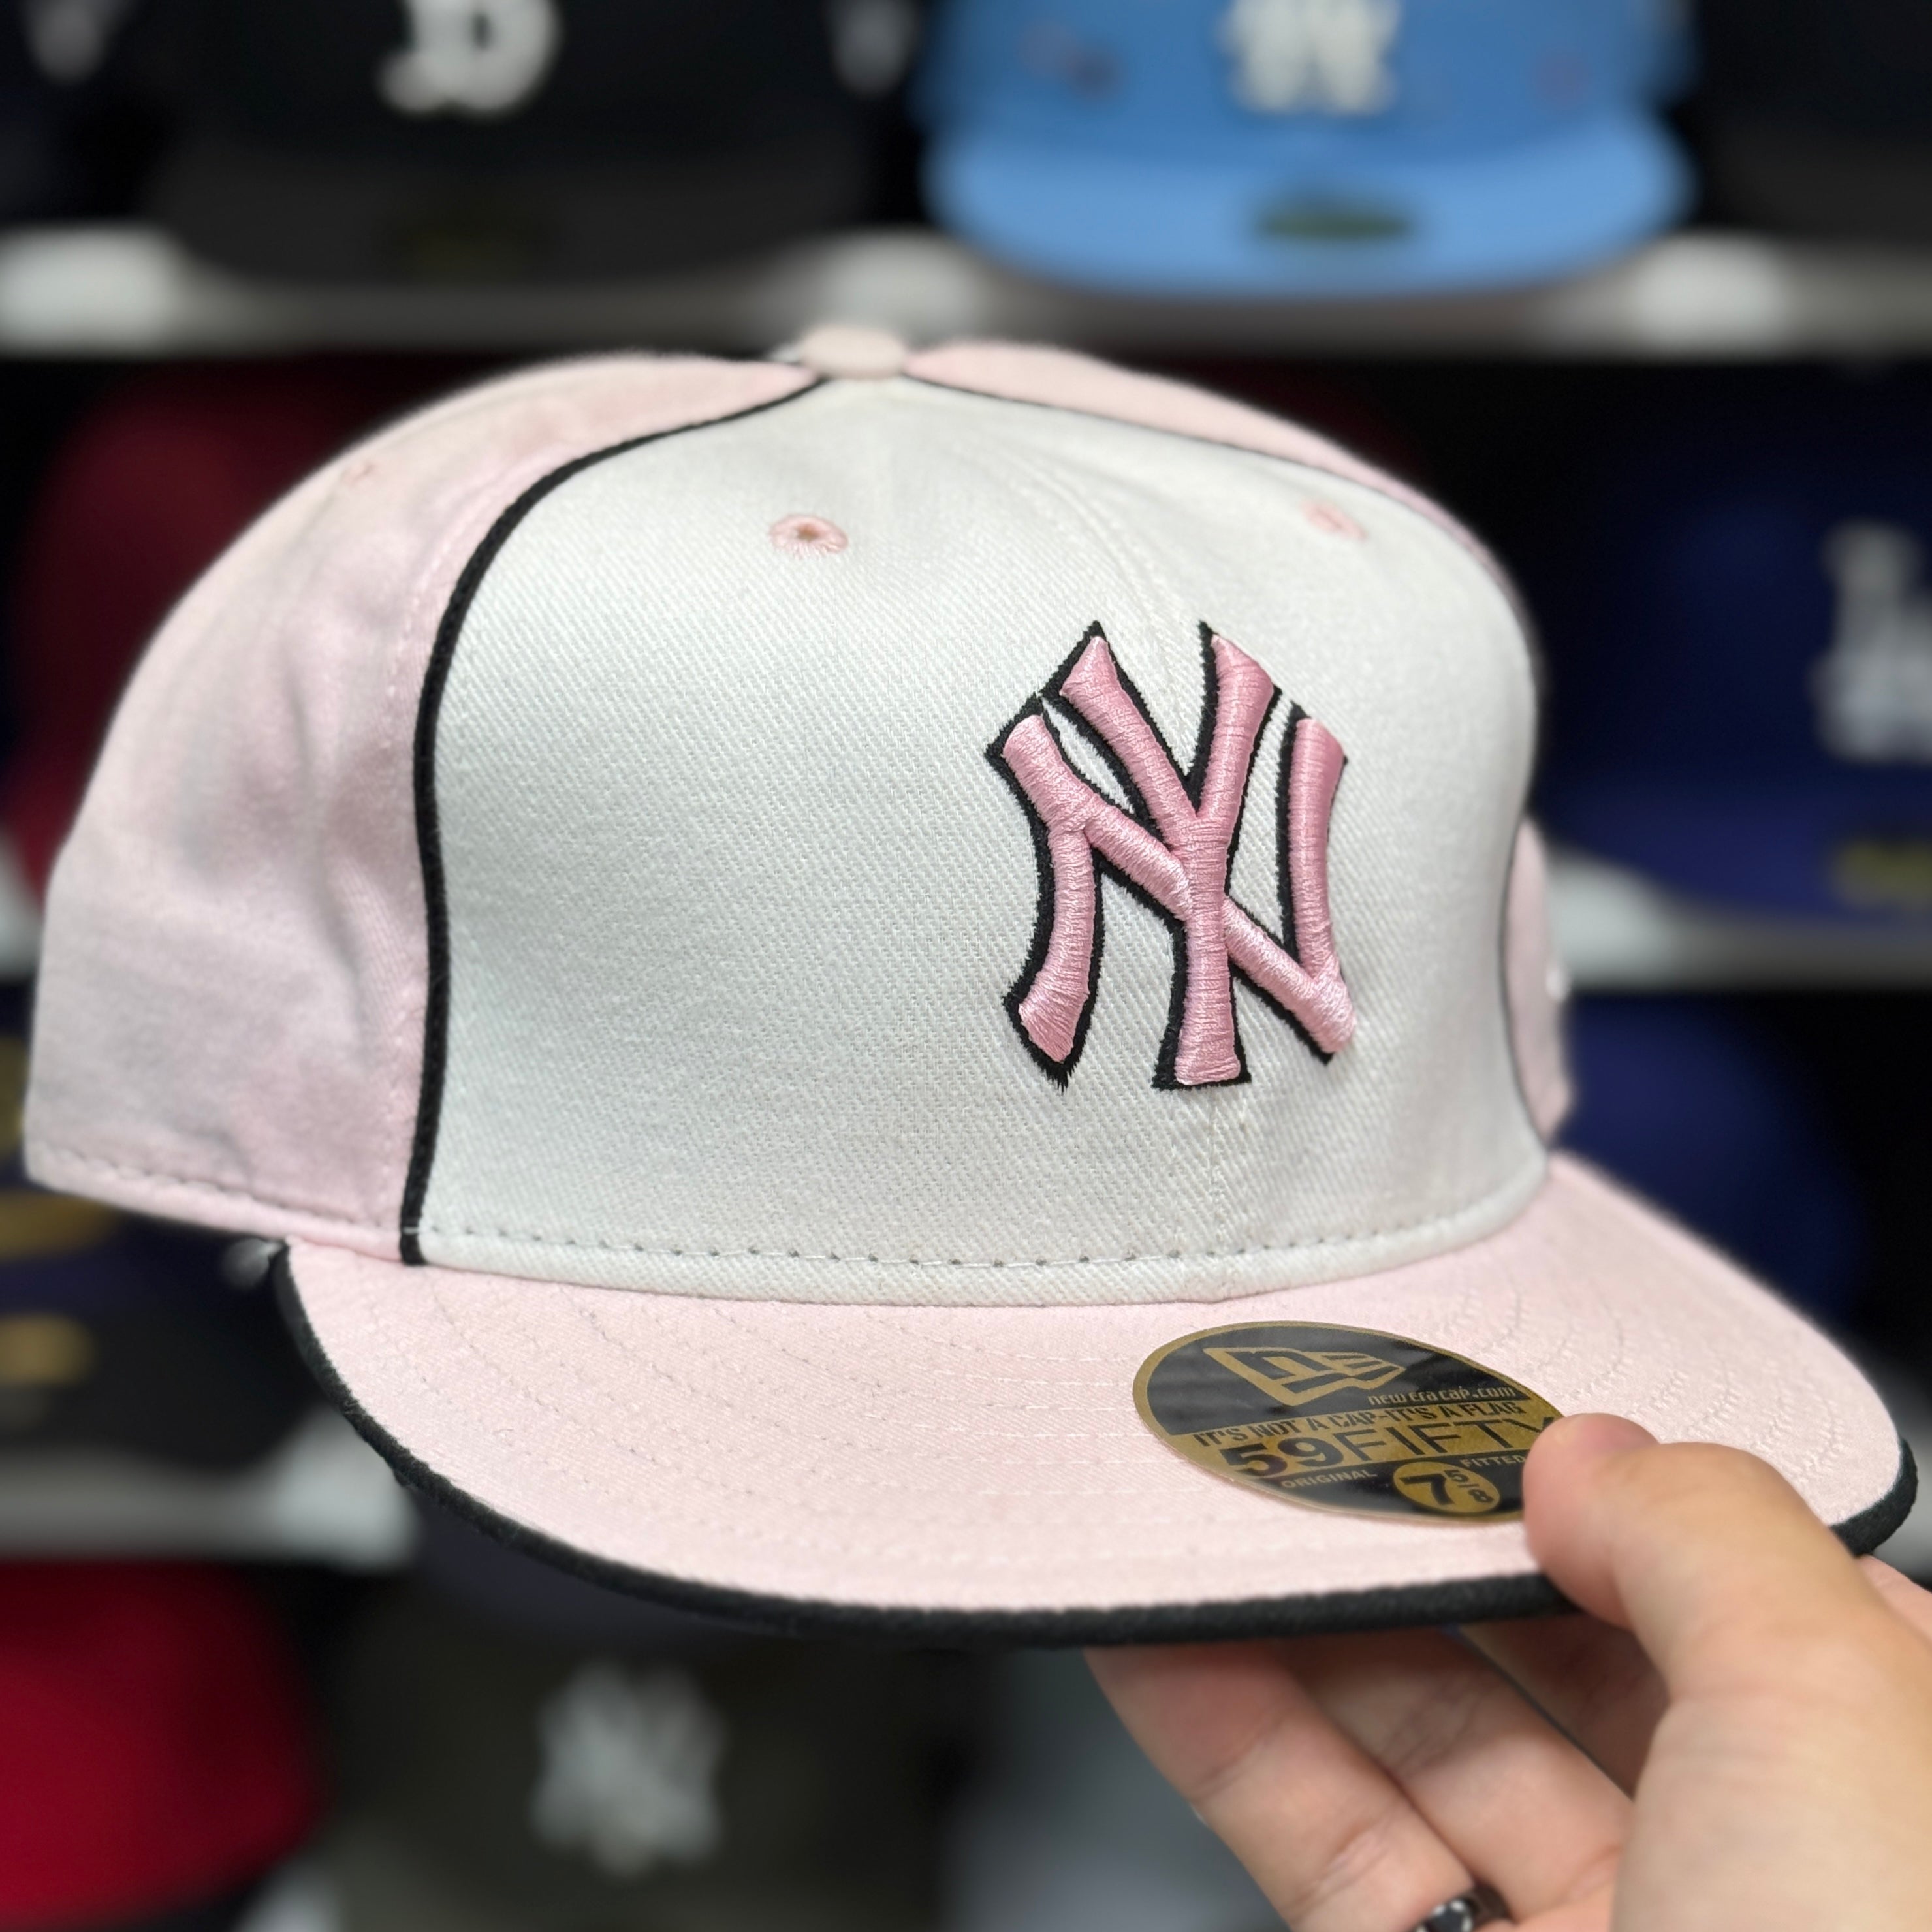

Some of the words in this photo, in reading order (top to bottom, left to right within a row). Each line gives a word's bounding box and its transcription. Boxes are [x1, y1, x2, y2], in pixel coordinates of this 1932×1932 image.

[984, 620, 1357, 1092] NY
[1194, 1428, 1246, 1446] IT'S
[1248, 1419, 1301, 1438] NOT
[1306, 1417, 1329, 1431] A
[1438, 1404, 1462, 1417] A
[1463, 1401, 1526, 1417] FLAG
[1460, 1455, 1525, 1468] FITTED
[1281, 1470, 1378, 1489] ORIGINAL
